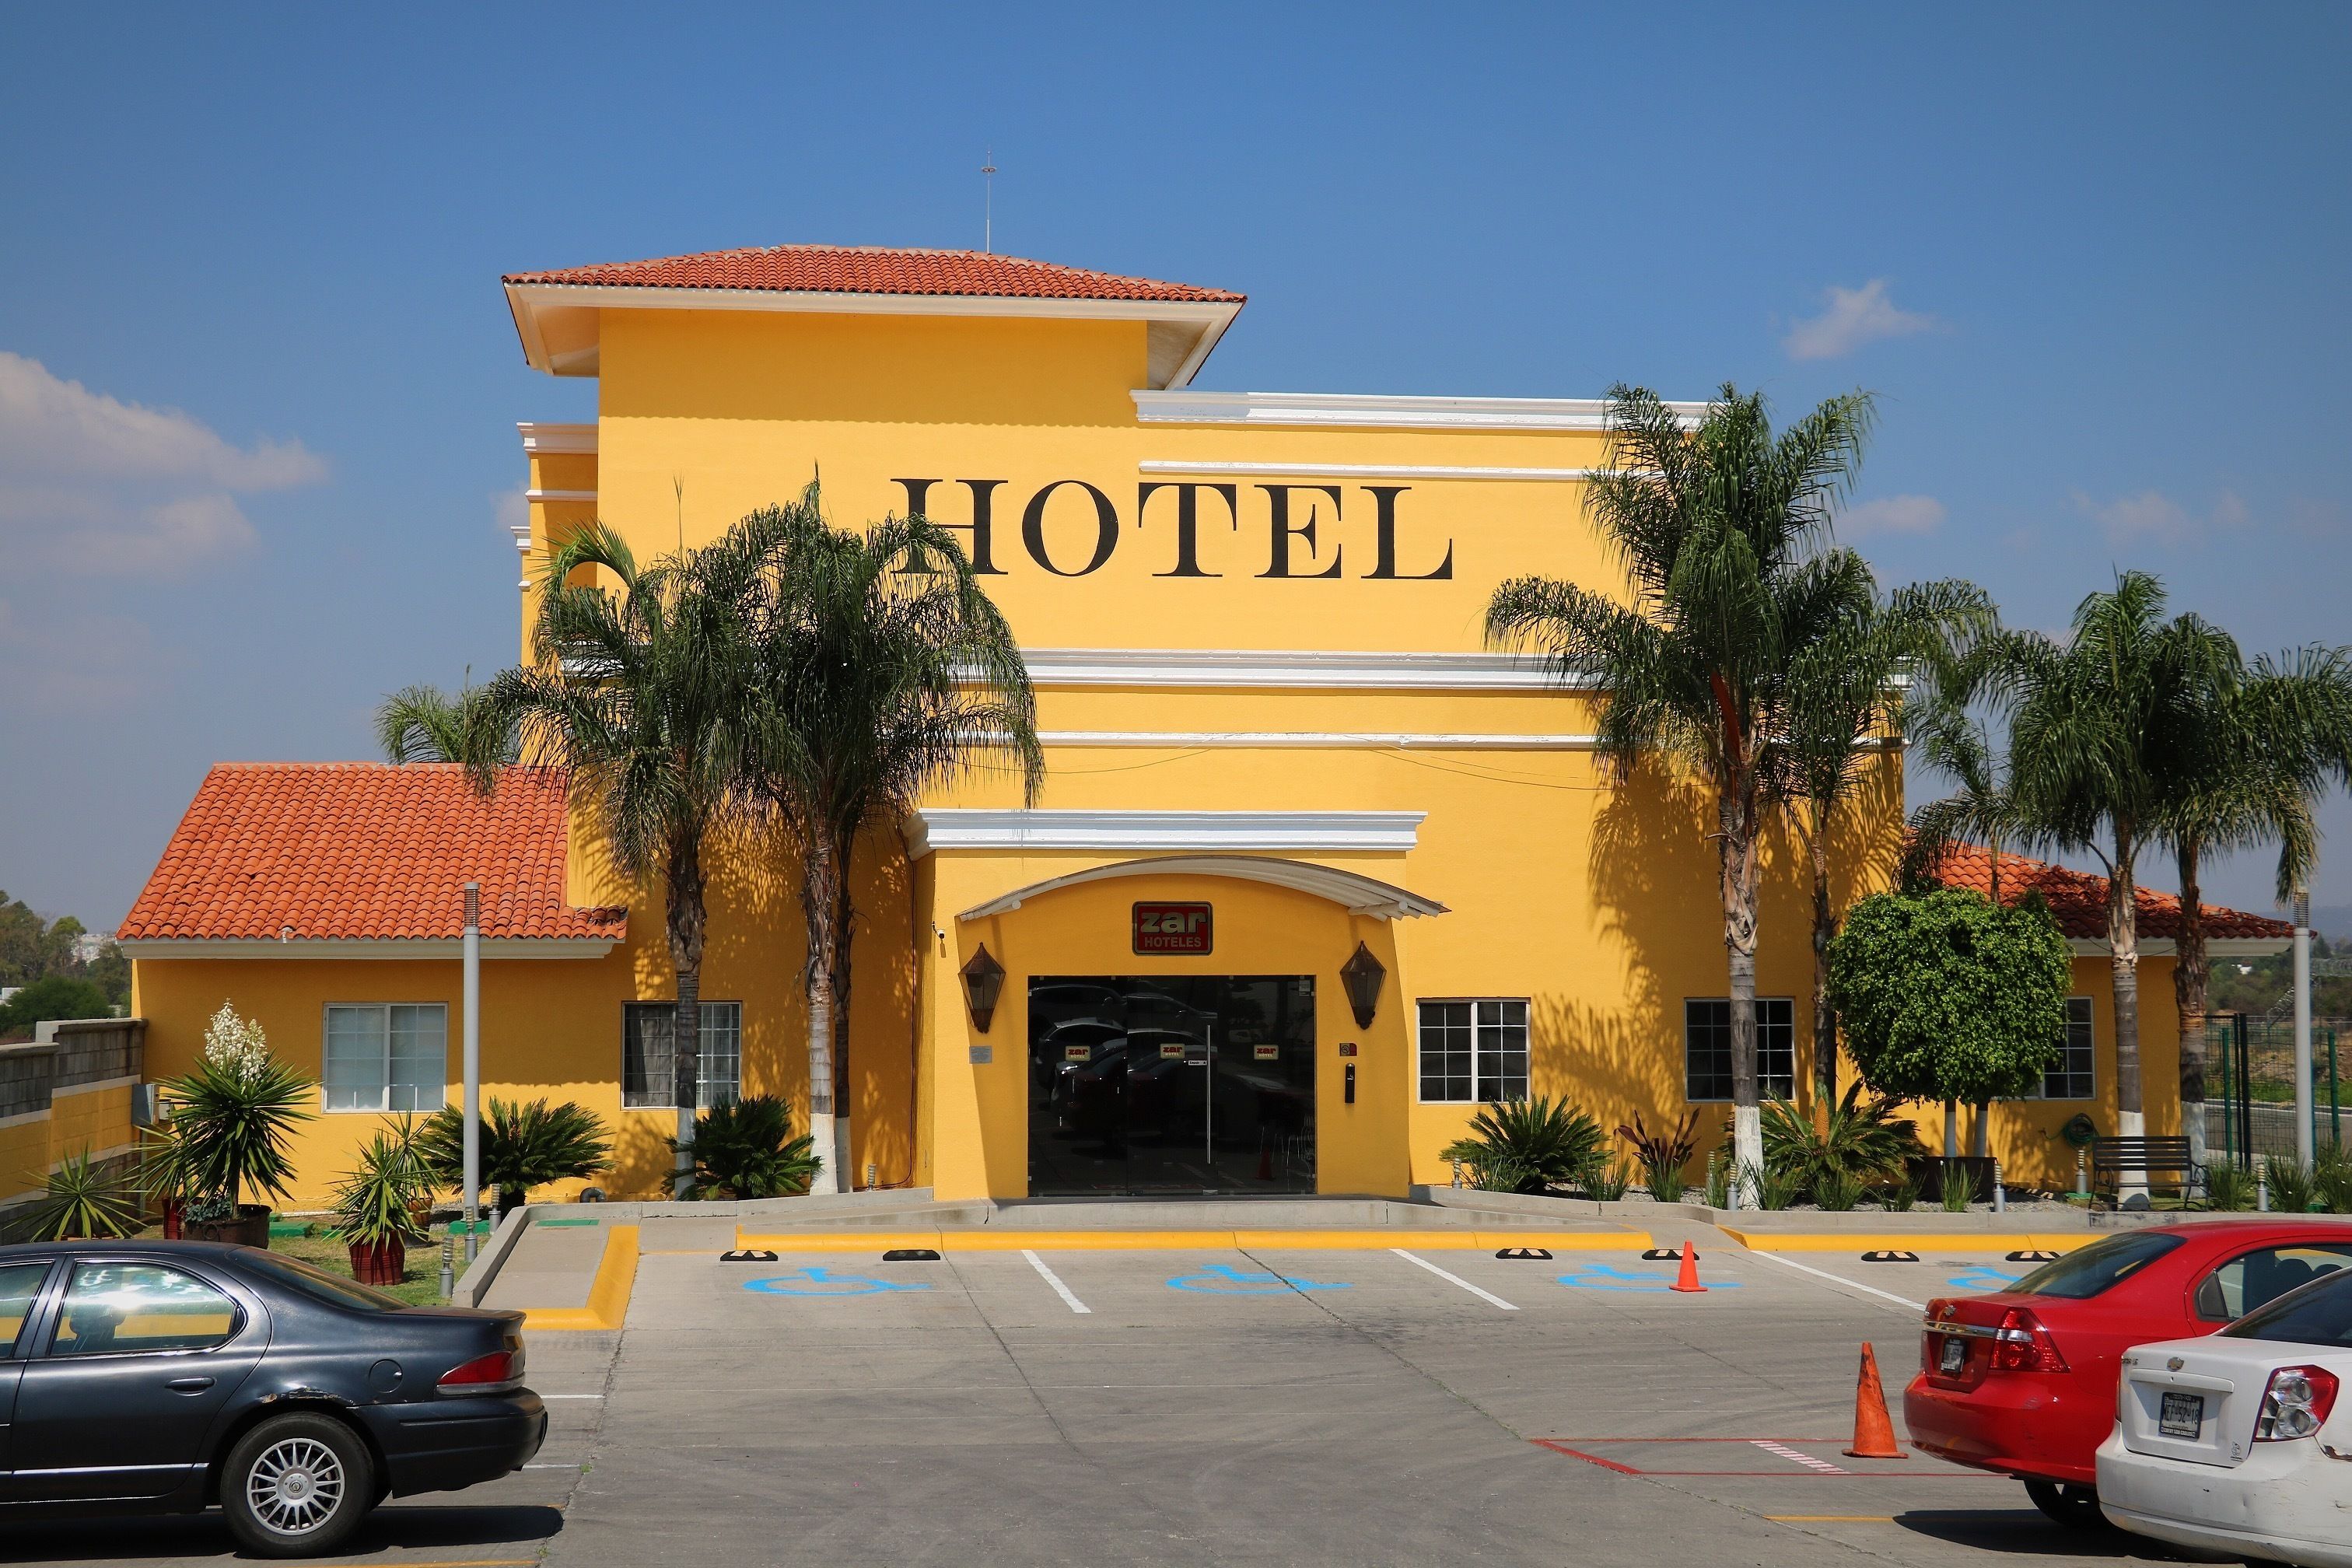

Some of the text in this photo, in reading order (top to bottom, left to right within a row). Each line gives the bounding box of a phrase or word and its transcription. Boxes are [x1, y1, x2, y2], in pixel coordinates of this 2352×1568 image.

[891, 478, 1453, 580] HOTEL
[1140, 912, 1207, 934] zar
[1144, 936, 1202, 947] HOTELES
